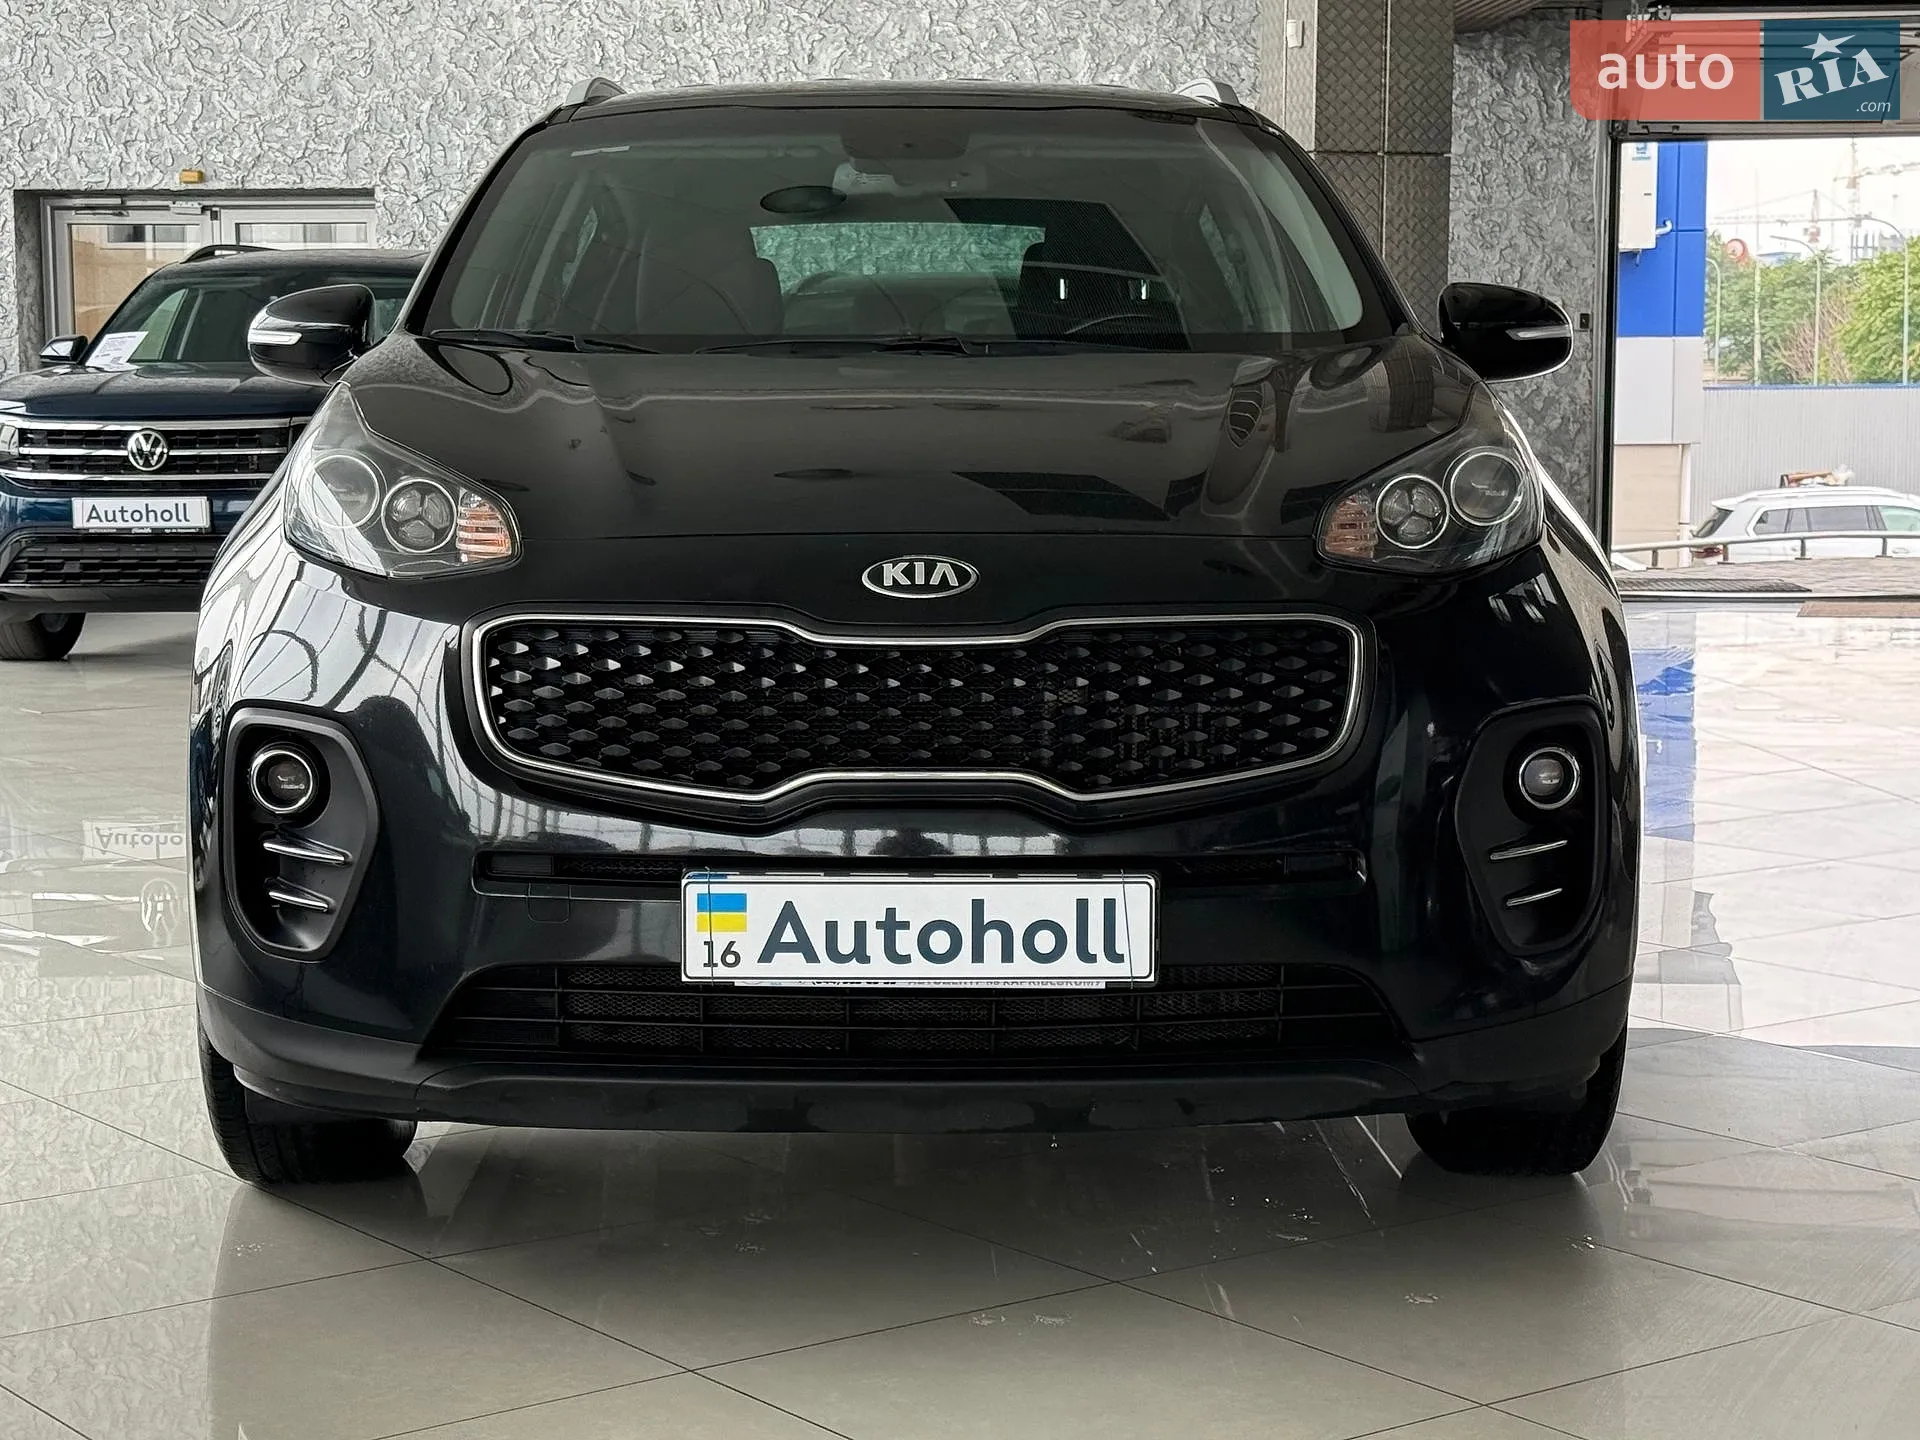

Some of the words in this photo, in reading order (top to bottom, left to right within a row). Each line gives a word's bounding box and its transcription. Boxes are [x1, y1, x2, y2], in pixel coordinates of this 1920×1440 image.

[86, 503, 190, 523] Autoholl
[881, 561, 959, 587] KIA
[756, 898, 1125, 964] Autoholl
[702, 941, 741, 968] 16
